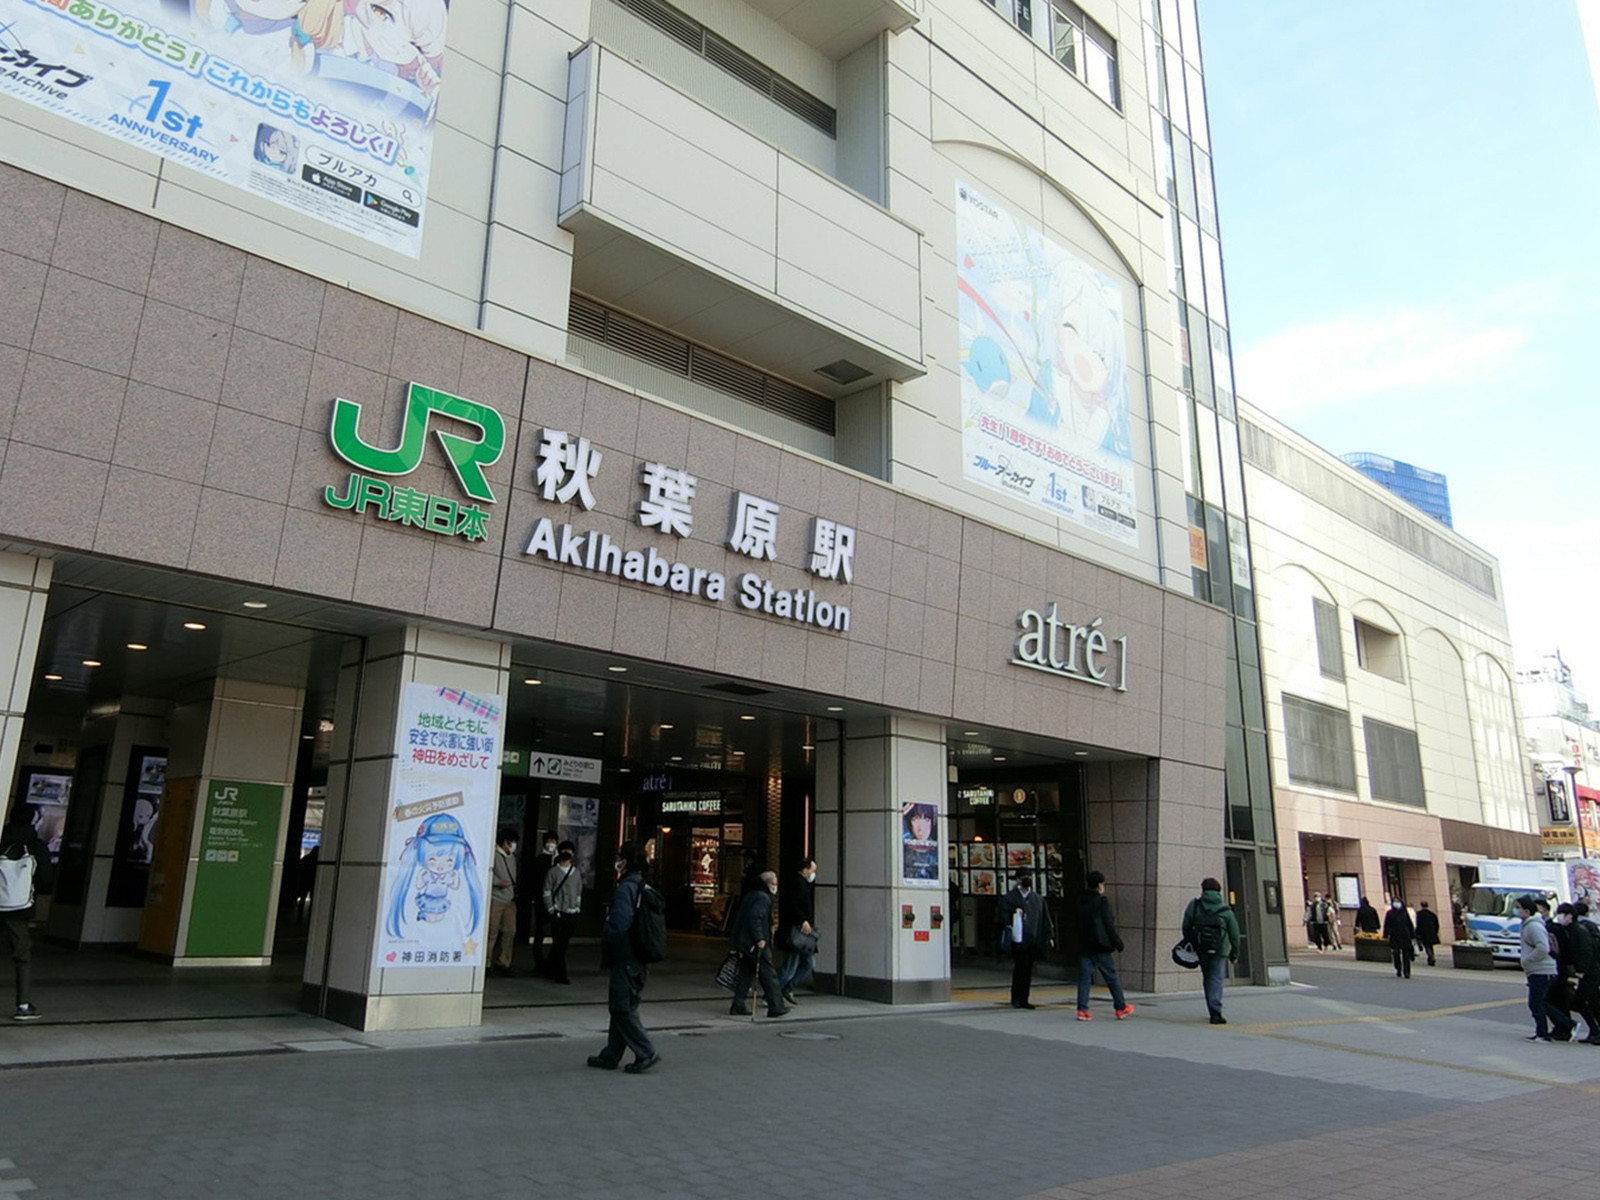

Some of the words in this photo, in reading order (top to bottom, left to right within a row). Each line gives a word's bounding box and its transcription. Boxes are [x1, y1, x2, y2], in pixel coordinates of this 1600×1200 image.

[0, 48, 94, 88] ーカイブ
[4, 71, 68, 100] Archive
[146, 80, 203, 139] 1st
[108, 113, 219, 163] ANNIVERSARY
[318, 152, 377, 188] ブルアカ
[330, 380, 506, 504] JR
[537, 427, 857, 584] 秋葉原駅
[1048, 472, 1068, 502] 1st
[324, 472, 492, 542] JR東日本
[525, 517, 727, 602] Akihabara
[739, 572, 851, 632] Station
[1014, 602, 1108, 680] atré
[1114, 635, 1128, 692] 1
[408, 728, 495, 753] 安全で災害に強い街
[418, 712, 489, 735] 地域とともに
[412, 748, 490, 769] 神田をめざして
[214, 787, 239, 801] JR
[698, 799, 721, 812] COFFEE
